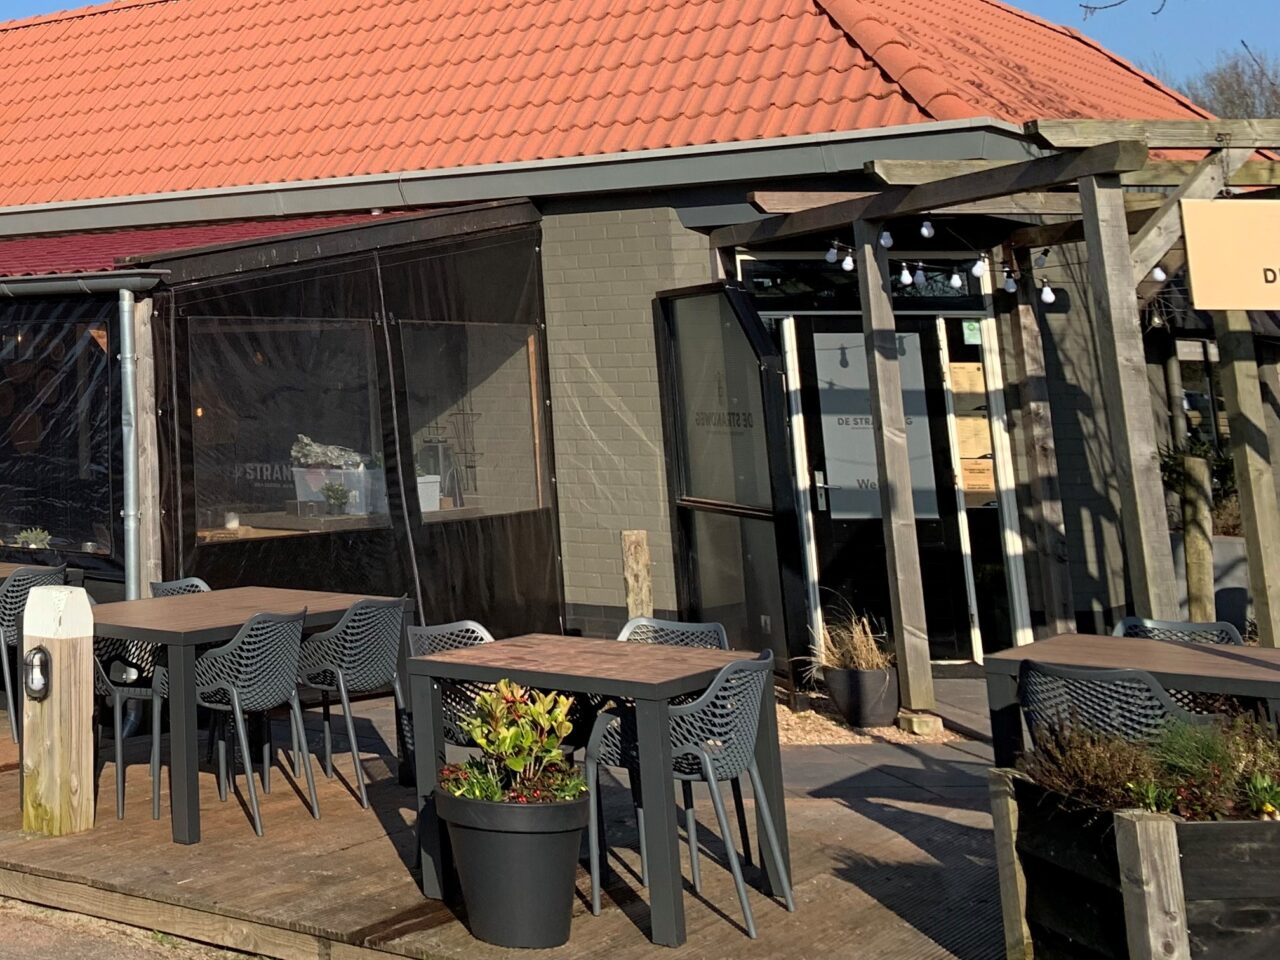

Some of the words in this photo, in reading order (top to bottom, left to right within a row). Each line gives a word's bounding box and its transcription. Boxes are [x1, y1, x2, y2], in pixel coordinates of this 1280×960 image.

[1263, 267, 1280, 284] D
[837, 417, 850, 426] DE
[245, 463, 294, 481] STRAN
